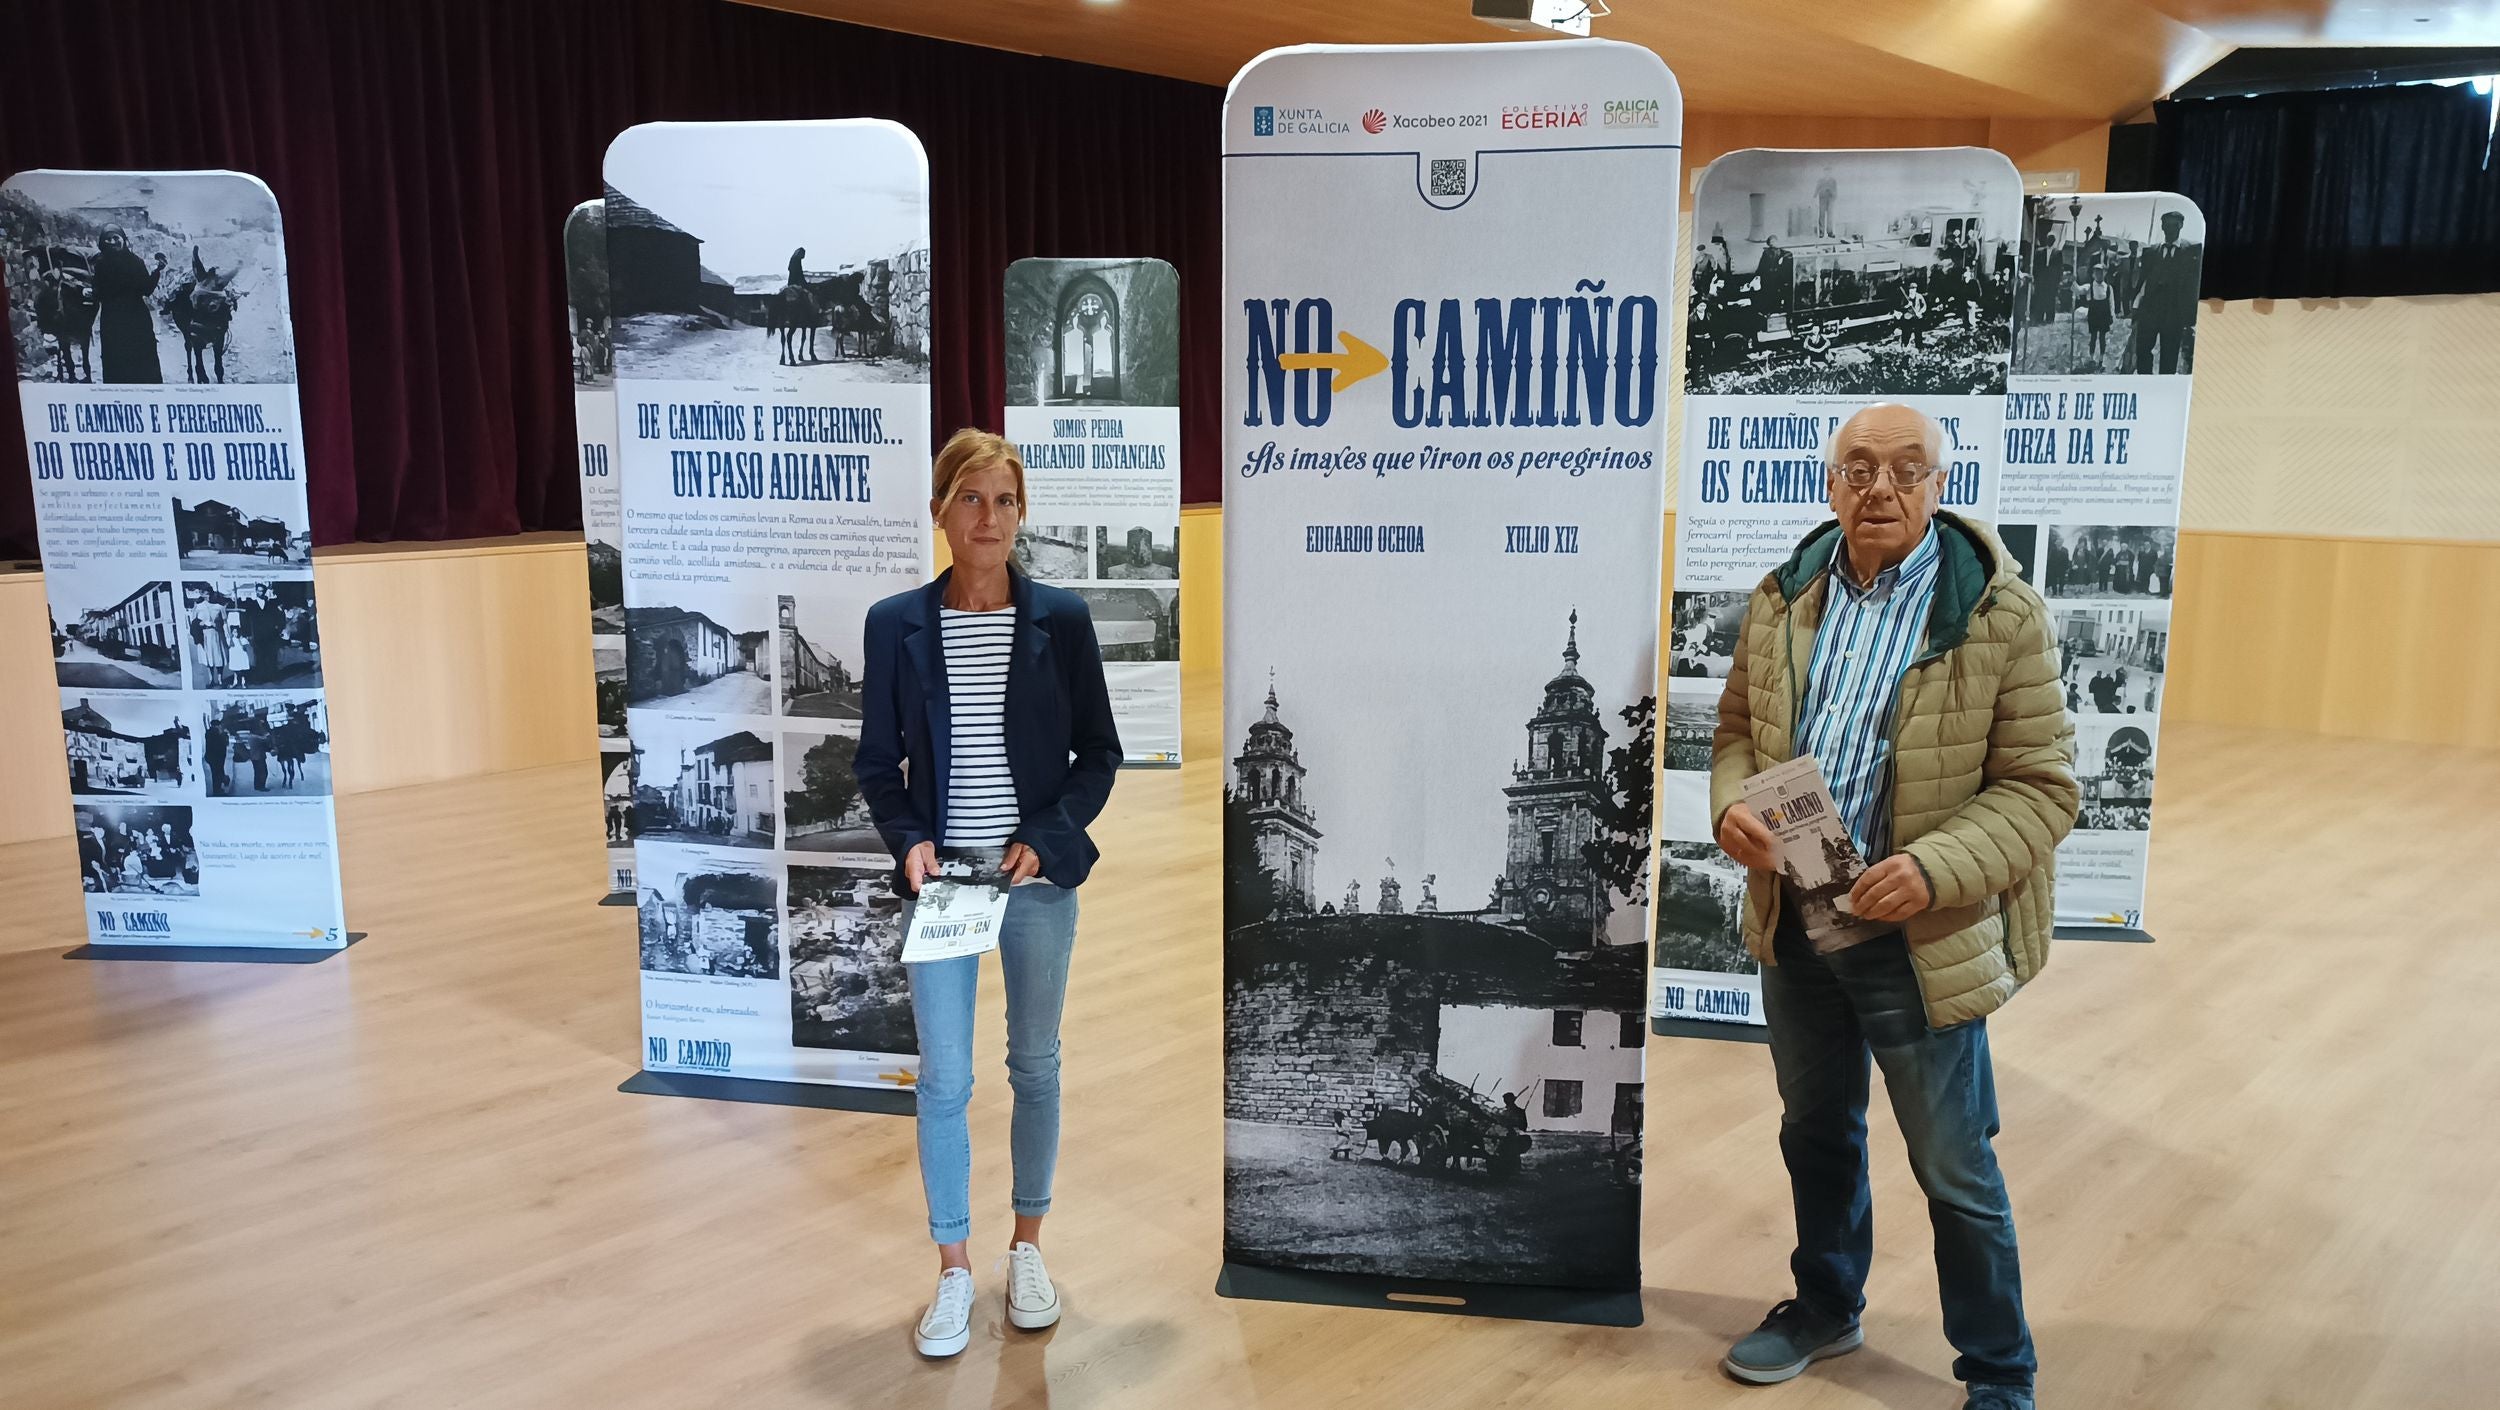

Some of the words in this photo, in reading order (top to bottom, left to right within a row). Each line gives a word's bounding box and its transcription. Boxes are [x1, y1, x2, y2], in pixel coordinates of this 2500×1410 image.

[1278, 108, 1323, 120] XUNTA
[1502, 104, 1589, 113] COLECTIVO
[1604, 100, 1659, 112] GALICIA
[1278, 122, 1295, 134] DE
[1298, 120, 1351, 135] GALICIA
[1393, 114, 1456, 129] Xacobeo
[1460, 114, 1488, 128] 2021
[1502, 112, 1582, 130] EGERIA
[1604, 111, 1659, 125] DIGITAL
[1242, 297, 1334, 428] NO
[1390, 279, 1658, 429] CAMIÑO
[2058, 393, 2067, 420] E
[2074, 393, 2095, 420] DE
[2103, 393, 2137, 420] VIDA
[48, 404, 69, 433] DE
[76, 400, 144, 433] CAMIÑOS
[152, 404, 161, 433] E
[167, 404, 282, 433] PEREGRINOS...
[638, 403, 660, 439] DE
[668, 400, 746, 441] CAMIÑOS
[754, 406, 764, 441] E
[772, 406, 903, 445] PEREGRINOS...
[1054, 419, 1087, 438] SOMOS
[1092, 419, 1124, 438] PEDRA
[1707, 416, 1732, 450] DE
[1740, 412, 1819, 450] CAMIÑOS
[2004, 428, 2056, 464] ORZA
[2067, 428, 2094, 464] DA
[2105, 428, 2130, 464] FE
[34, 442, 64, 480] DO
[70, 442, 155, 481] URBANO
[164, 443, 177, 481] E
[186, 443, 216, 481] DO
[224, 443, 295, 481] RURAL
[583, 444, 608, 477] DO
[1092, 444, 1166, 470] DISTANCIAS
[1242, 441, 1284, 479] As
[1289, 445, 1367, 478] imaxes
[1372, 450, 1413, 478] que
[1418, 444, 1481, 471] viron
[1487, 450, 1514, 470] os
[1516, 447, 1653, 478] peregrinos
[671, 450, 702, 498] UN
[707, 451, 764, 499] PASO
[770, 453, 871, 503] ADIANTE
[1702, 460, 1730, 504] OS
[627, 509, 634, 519] O
[637, 512, 666, 520] mesmo
[668, 514, 683, 523] que
[686, 510, 709, 521] todos
[720, 512, 756, 522] camiños
[758, 512, 779, 523] levan
[789, 514, 813, 524] Roma
[884, 518, 911, 528] tamén
[1688, 516, 1717, 528] Seguía
[1728, 518, 1770, 529] peregrino
[1782, 517, 1818, 526] camiñar
[628, 526, 658, 535] terceira
[661, 526, 688, 536] cidade
[690, 528, 713, 537] santa
[715, 527, 730, 537] dos
[770, 528, 792, 539] levan
[794, 529, 817, 540] todos
[830, 532, 867, 542] camiños
[869, 536, 884, 546] que
[1306, 526, 1373, 553] EDUARDO
[1378, 526, 1425, 553] OCHOA
[1505, 526, 1550, 554] XULIO
[1554, 526, 1579, 554] XIZ
[1686, 530, 1732, 542] ferrocarril
[1736, 530, 1788, 541] proclamaba
[672, 541, 678, 550] E
[688, 542, 708, 552] cada
[712, 544, 730, 555] paso
[733, 542, 744, 552] do
[792, 547, 831, 558] aparecen
[834, 547, 870, 560] pegadas
[872, 548, 884, 558] do
[1687, 543, 1728, 554] resultaría
[628, 556, 660, 565] camiño
[688, 556, 720, 567] acollida
[788, 560, 828, 571] evidencia
[832, 562, 842, 572] de
[846, 566, 863, 576] que
[874, 562, 887, 576] fin
[890, 564, 901, 574] do
[1686, 558, 1708, 567] lento
[1710, 560, 1758, 571] peregrinar,
[630, 570, 662, 580] Camiño
[664, 571, 680, 580] está
[1686, 574, 1724, 582] cruzarse.
[1780, 792, 1825, 824] CAMIÑO
[617, 869, 632, 887] NO
[98, 911, 116, 931] NO
[122, 910, 171, 932] CAMIÑO
[326, 928, 338, 941] 5
[646, 1000, 653, 1008] O
[1665, 986, 1684, 1010] NO
[1696, 988, 1750, 1016] CAMIÑO
[648, 1036, 667, 1062] NO
[678, 1038, 732, 1067] CAMIÑO
